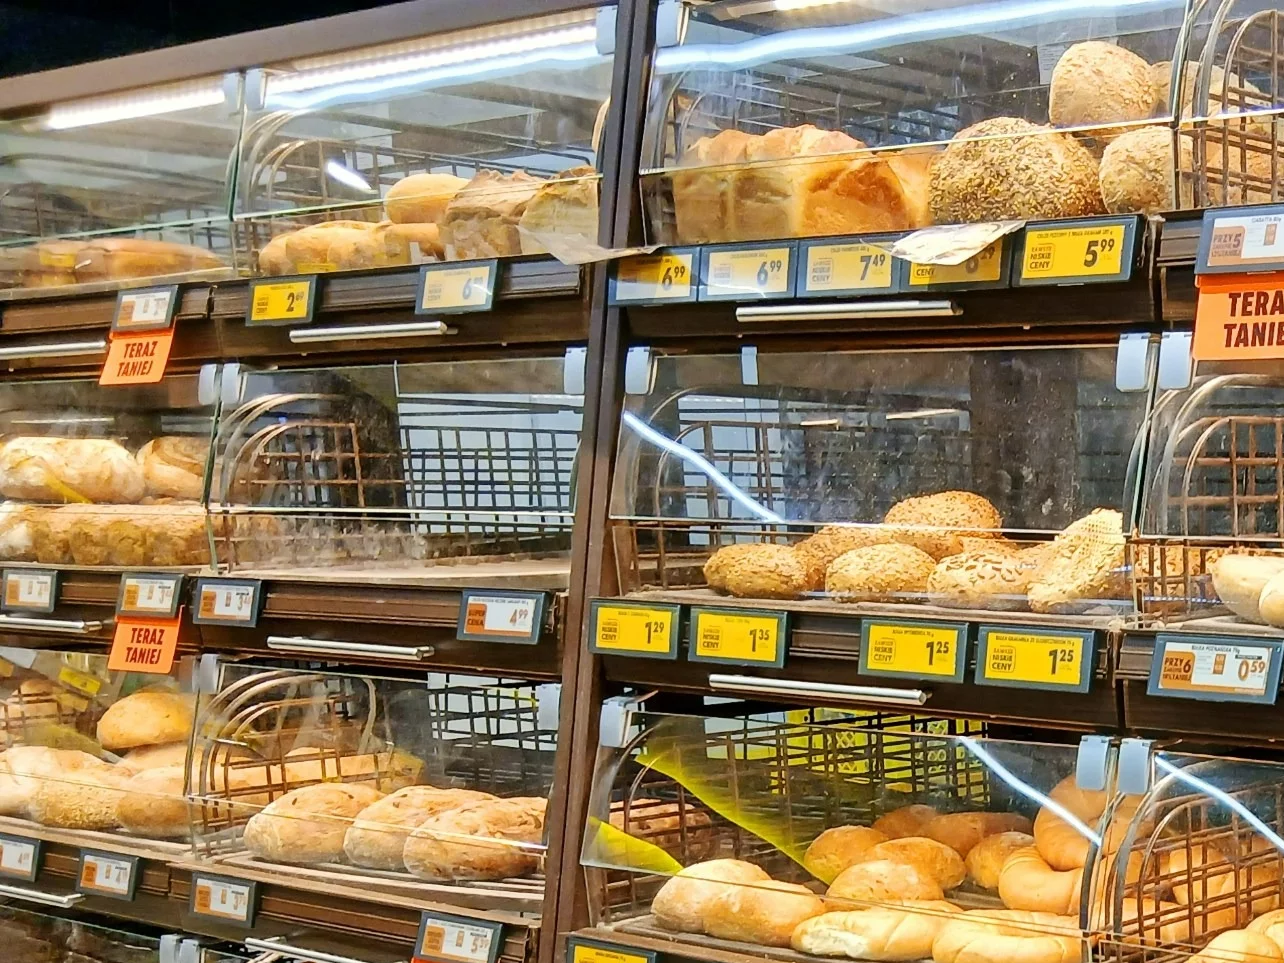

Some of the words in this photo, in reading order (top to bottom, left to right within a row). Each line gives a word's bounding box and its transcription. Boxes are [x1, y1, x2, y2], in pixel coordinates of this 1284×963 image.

[1232, 232, 1242, 249] 5
[1029, 260, 1049, 269] CENY
[916, 267, 935, 277] CENY
[123, 340, 159, 361] TERAZ
[117, 360, 154, 378] TANIEJ
[130, 628, 166, 646] TERAZ
[601, 633, 617, 642] CENY
[702, 641, 719, 650] CENY
[125, 647, 162, 665] TANIEJ
[873, 653, 892, 663] CENY
[992, 653, 1013, 662] NISKIE
[991, 662, 1012, 672] CENY
[1164, 656, 1183, 667] PRZY
[1183, 659, 1192, 674] 6
